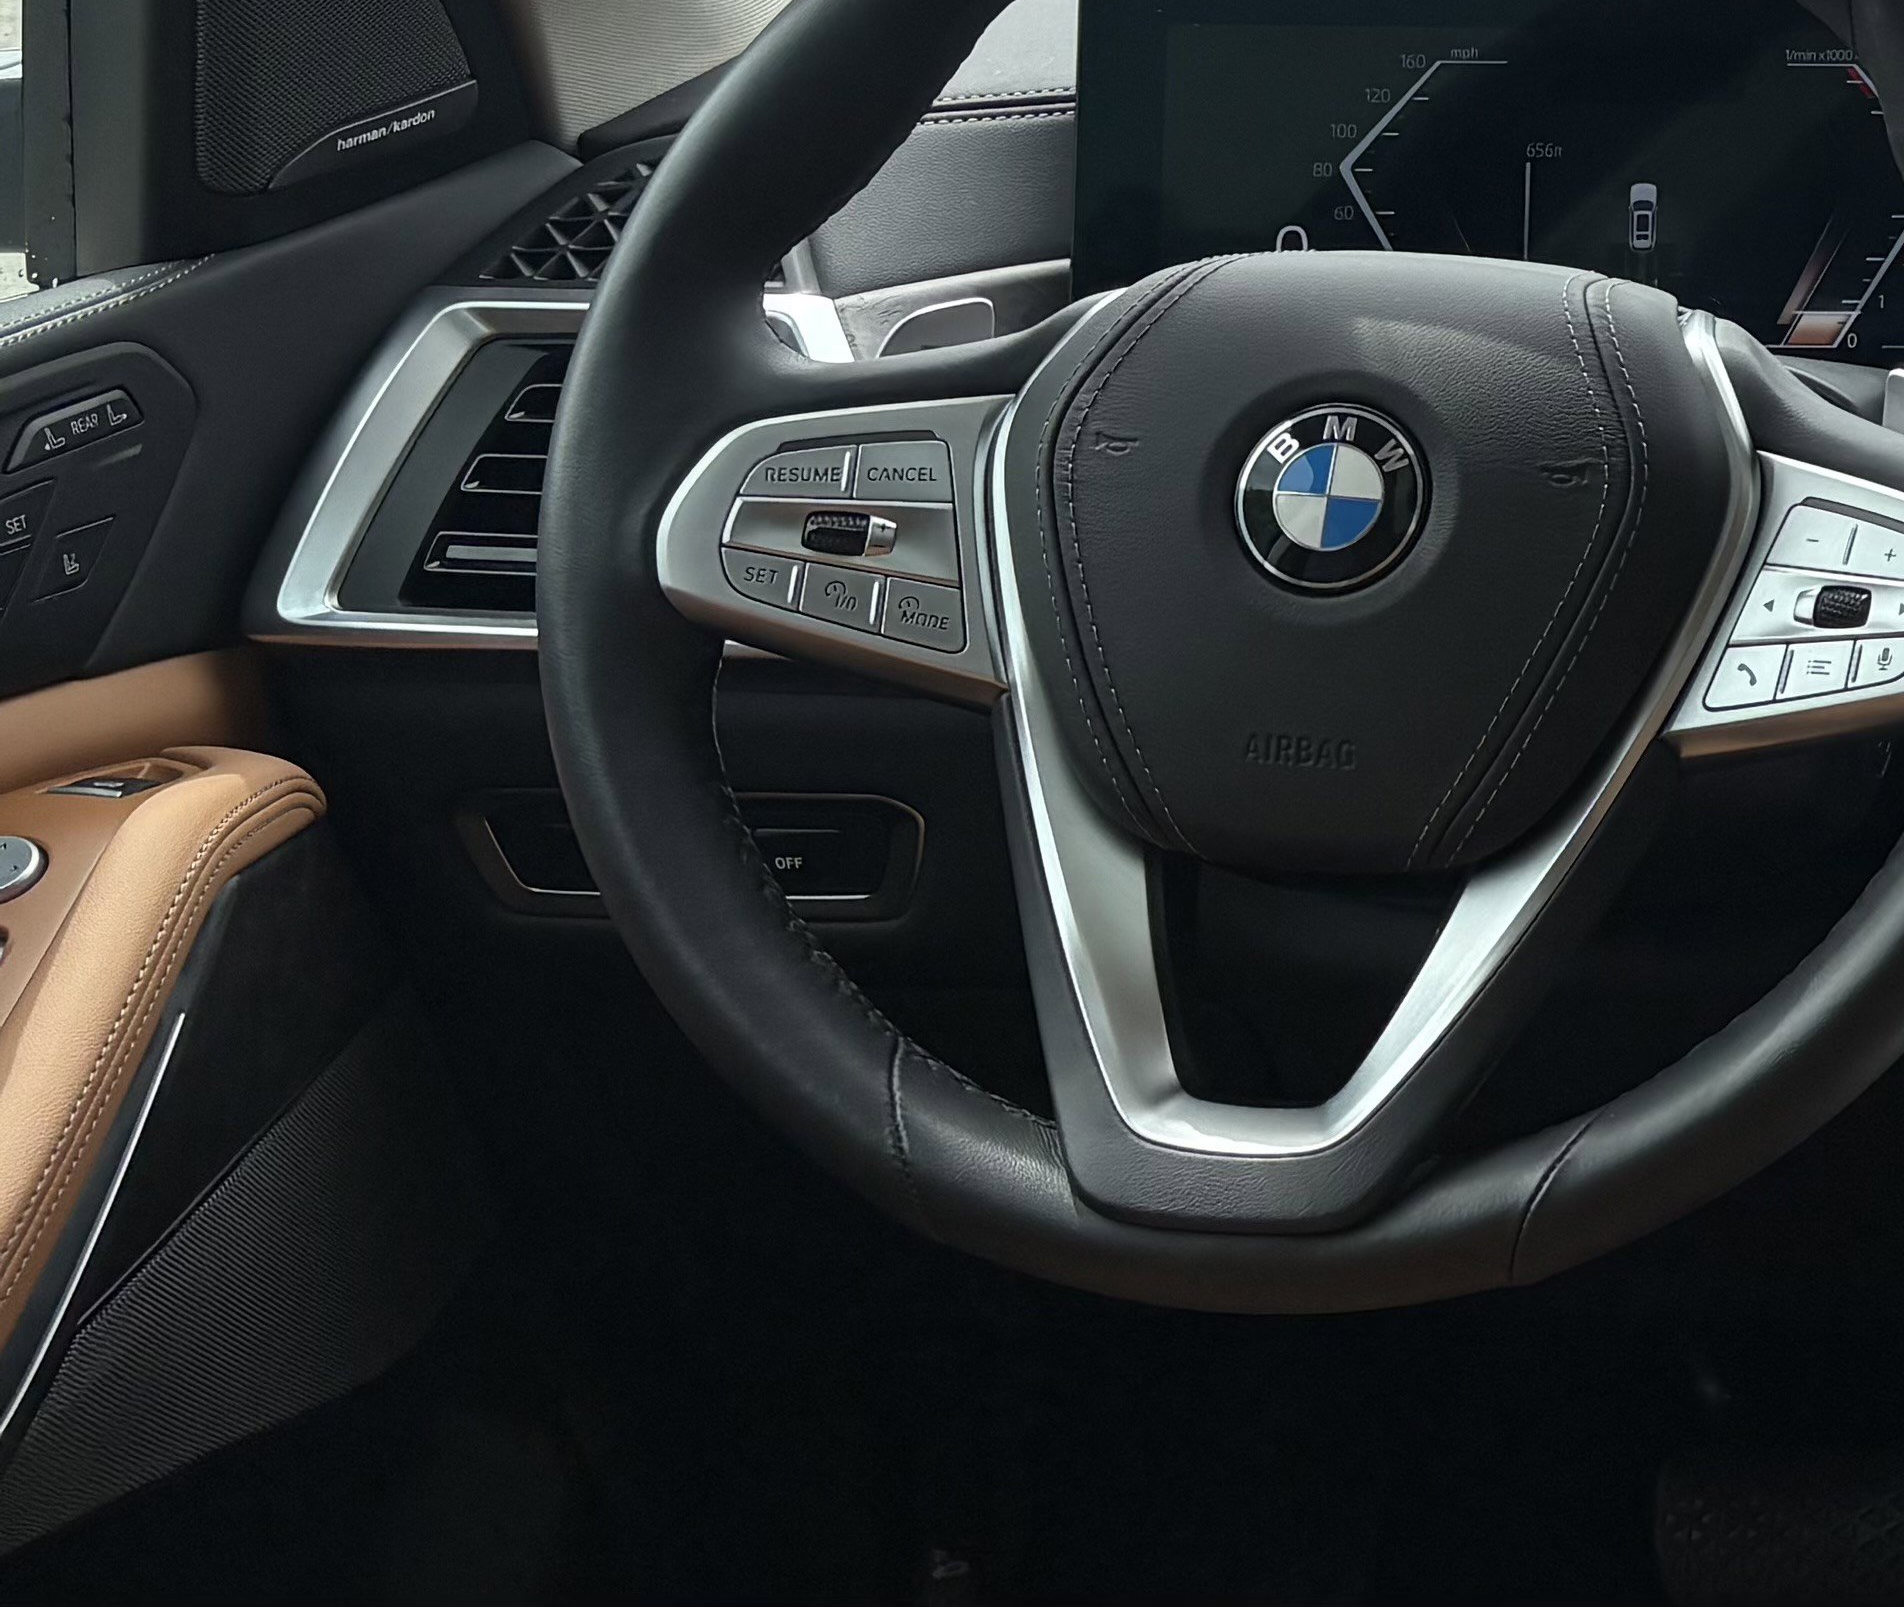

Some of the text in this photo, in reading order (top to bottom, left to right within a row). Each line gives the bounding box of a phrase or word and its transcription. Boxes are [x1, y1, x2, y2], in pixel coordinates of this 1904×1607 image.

[1450, 46, 1479, 59] mph
[1400, 53, 1427, 69] 160
[1365, 88, 1391, 104] 120
[336, 109, 436, 152] harman/kardon
[1329, 123, 1357, 139] 100
[1312, 162, 1333, 178] 80
[1333, 206, 1354, 222] 60
[1877, 294, 1885, 309] 1
[1847, 333, 1858, 348] 0
[70, 413, 99, 435] REAR
[1266, 415, 1409, 473] BMW
[763, 465, 841, 483] RESUME
[866, 466, 938, 483] CANCEL
[5, 514, 27, 535] SET
[743, 566, 779, 585] SET
[899, 607, 950, 631] MODE
[1244, 732, 1356, 771] AIRBAG
[774, 856, 804, 870] OFF
